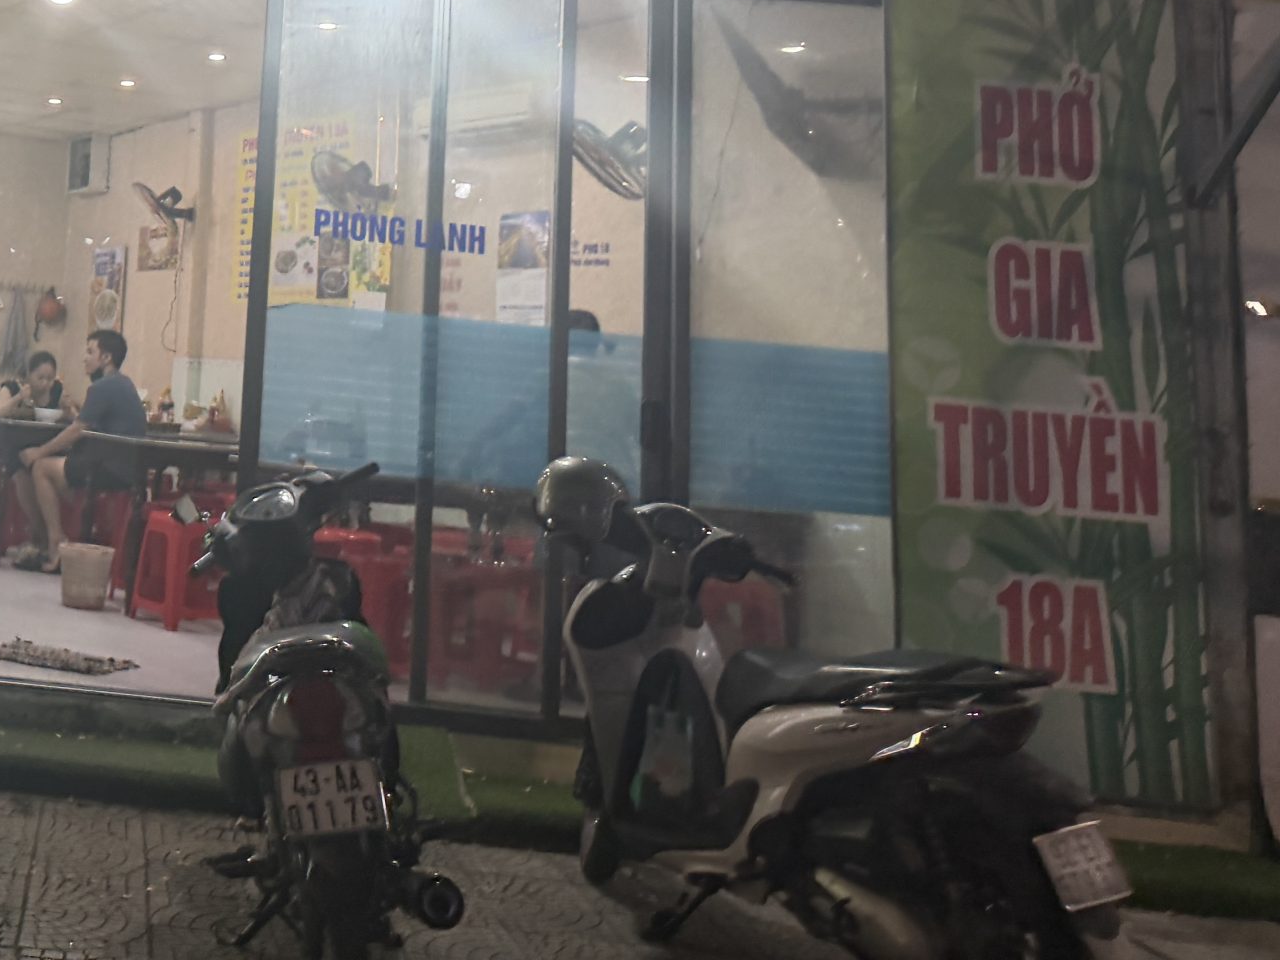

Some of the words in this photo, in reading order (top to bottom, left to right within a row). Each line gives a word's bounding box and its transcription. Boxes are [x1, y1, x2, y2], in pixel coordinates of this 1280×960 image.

[977, 68, 1098, 185] PHỞ
[314, 205, 405, 246] PHÒNG
[990, 242, 1097, 346] GIA
[931, 380, 1164, 519] TRUYỀN
[994, 577, 1111, 687] 18A
